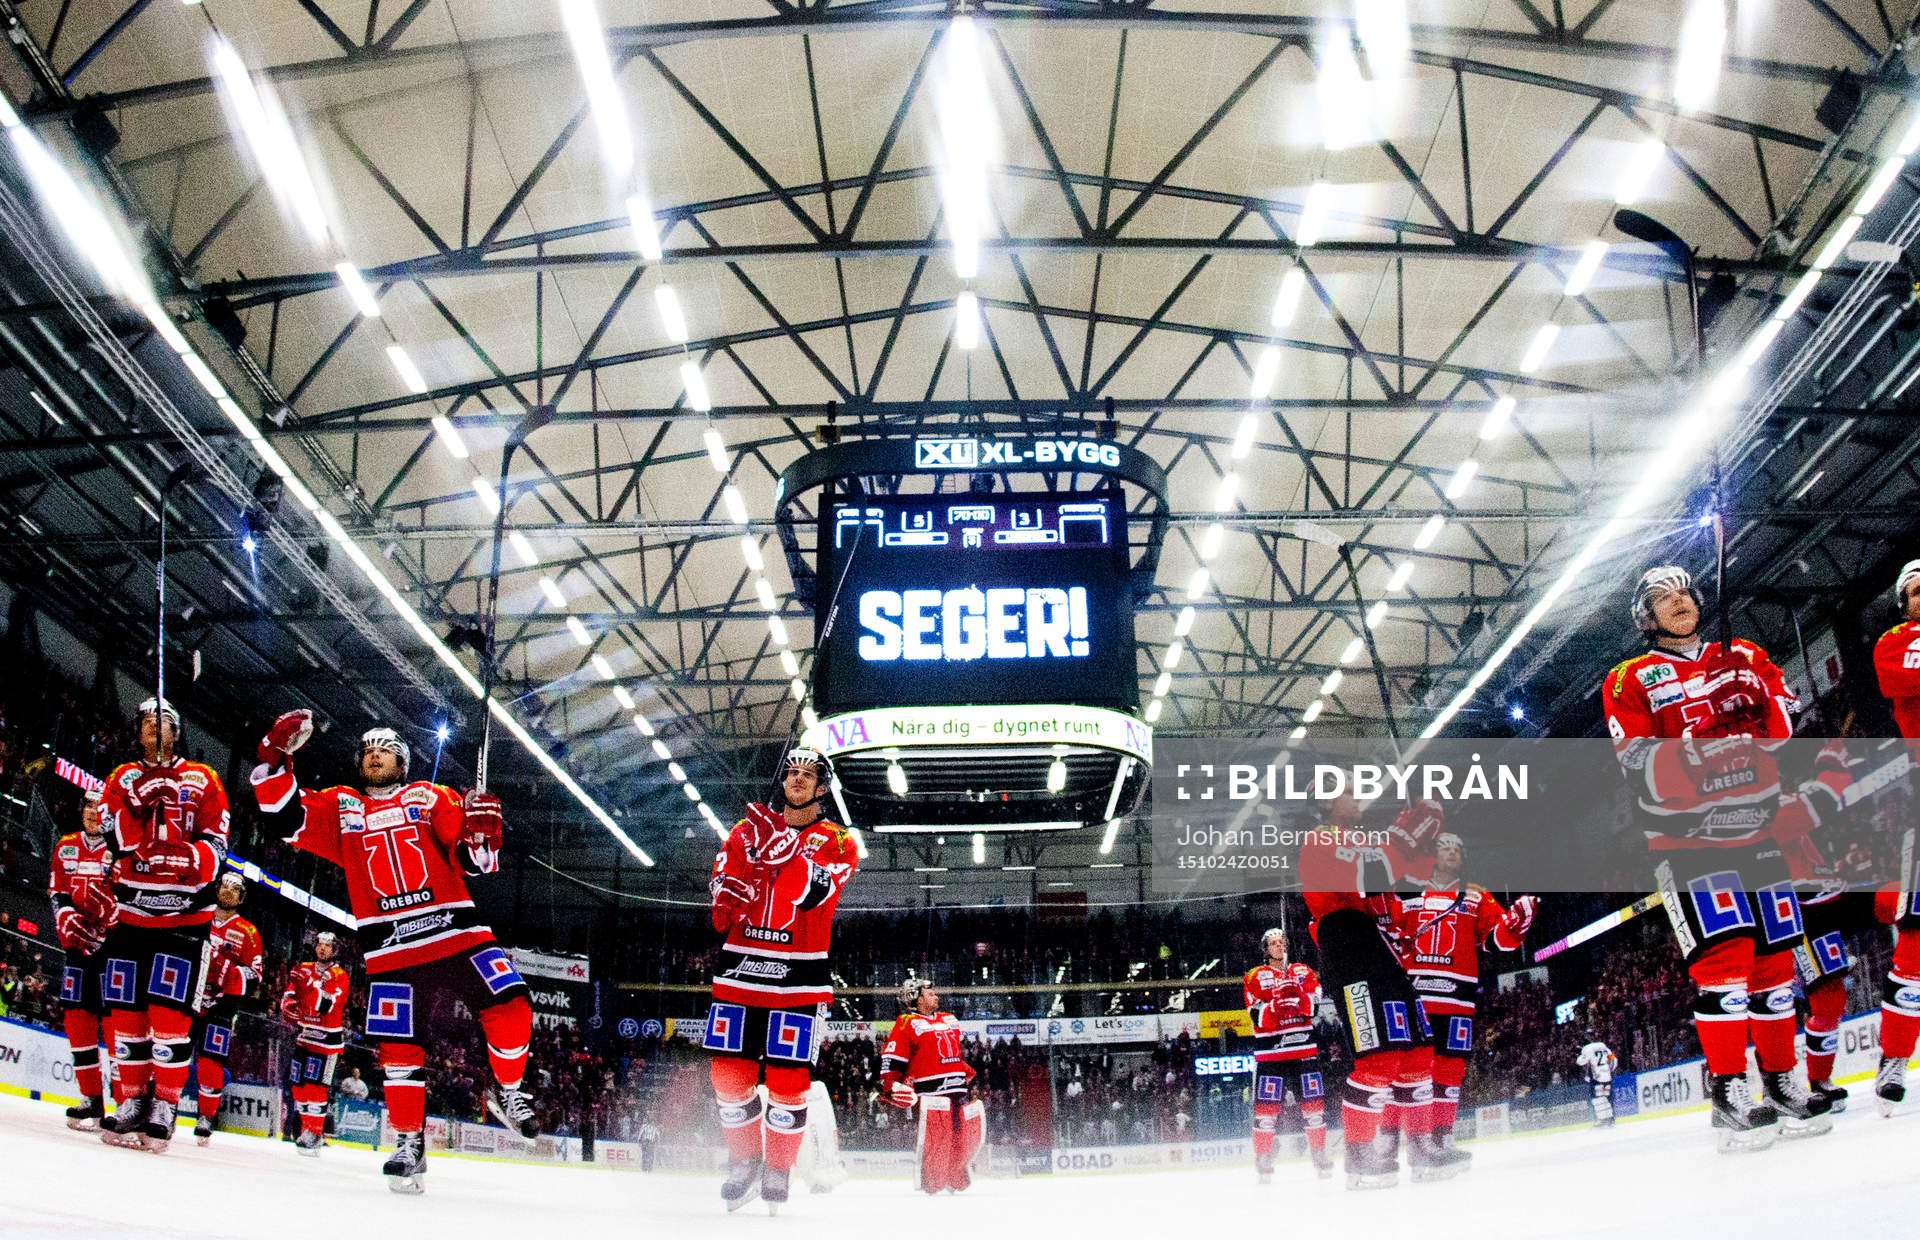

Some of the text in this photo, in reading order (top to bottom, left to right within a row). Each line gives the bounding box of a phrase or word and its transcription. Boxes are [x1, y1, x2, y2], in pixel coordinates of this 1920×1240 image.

[982, 441, 1120, 467] XL-BYGG
[858, 585, 1090, 661] SEGER!
[826, 717, 872, 751] NA
[892, 719, 936, 735] Nära
[943, 718, 971, 737] dig
[993, 718, 1059, 737] dygnet
[1064, 719, 1102, 736] runt
[381, 890, 431, 910] ÖREBRO
[745, 925, 790, 943] ÖREBRO
[1095, 1018, 1123, 1029] Let's
[606, 1149, 635, 1161] EEL
